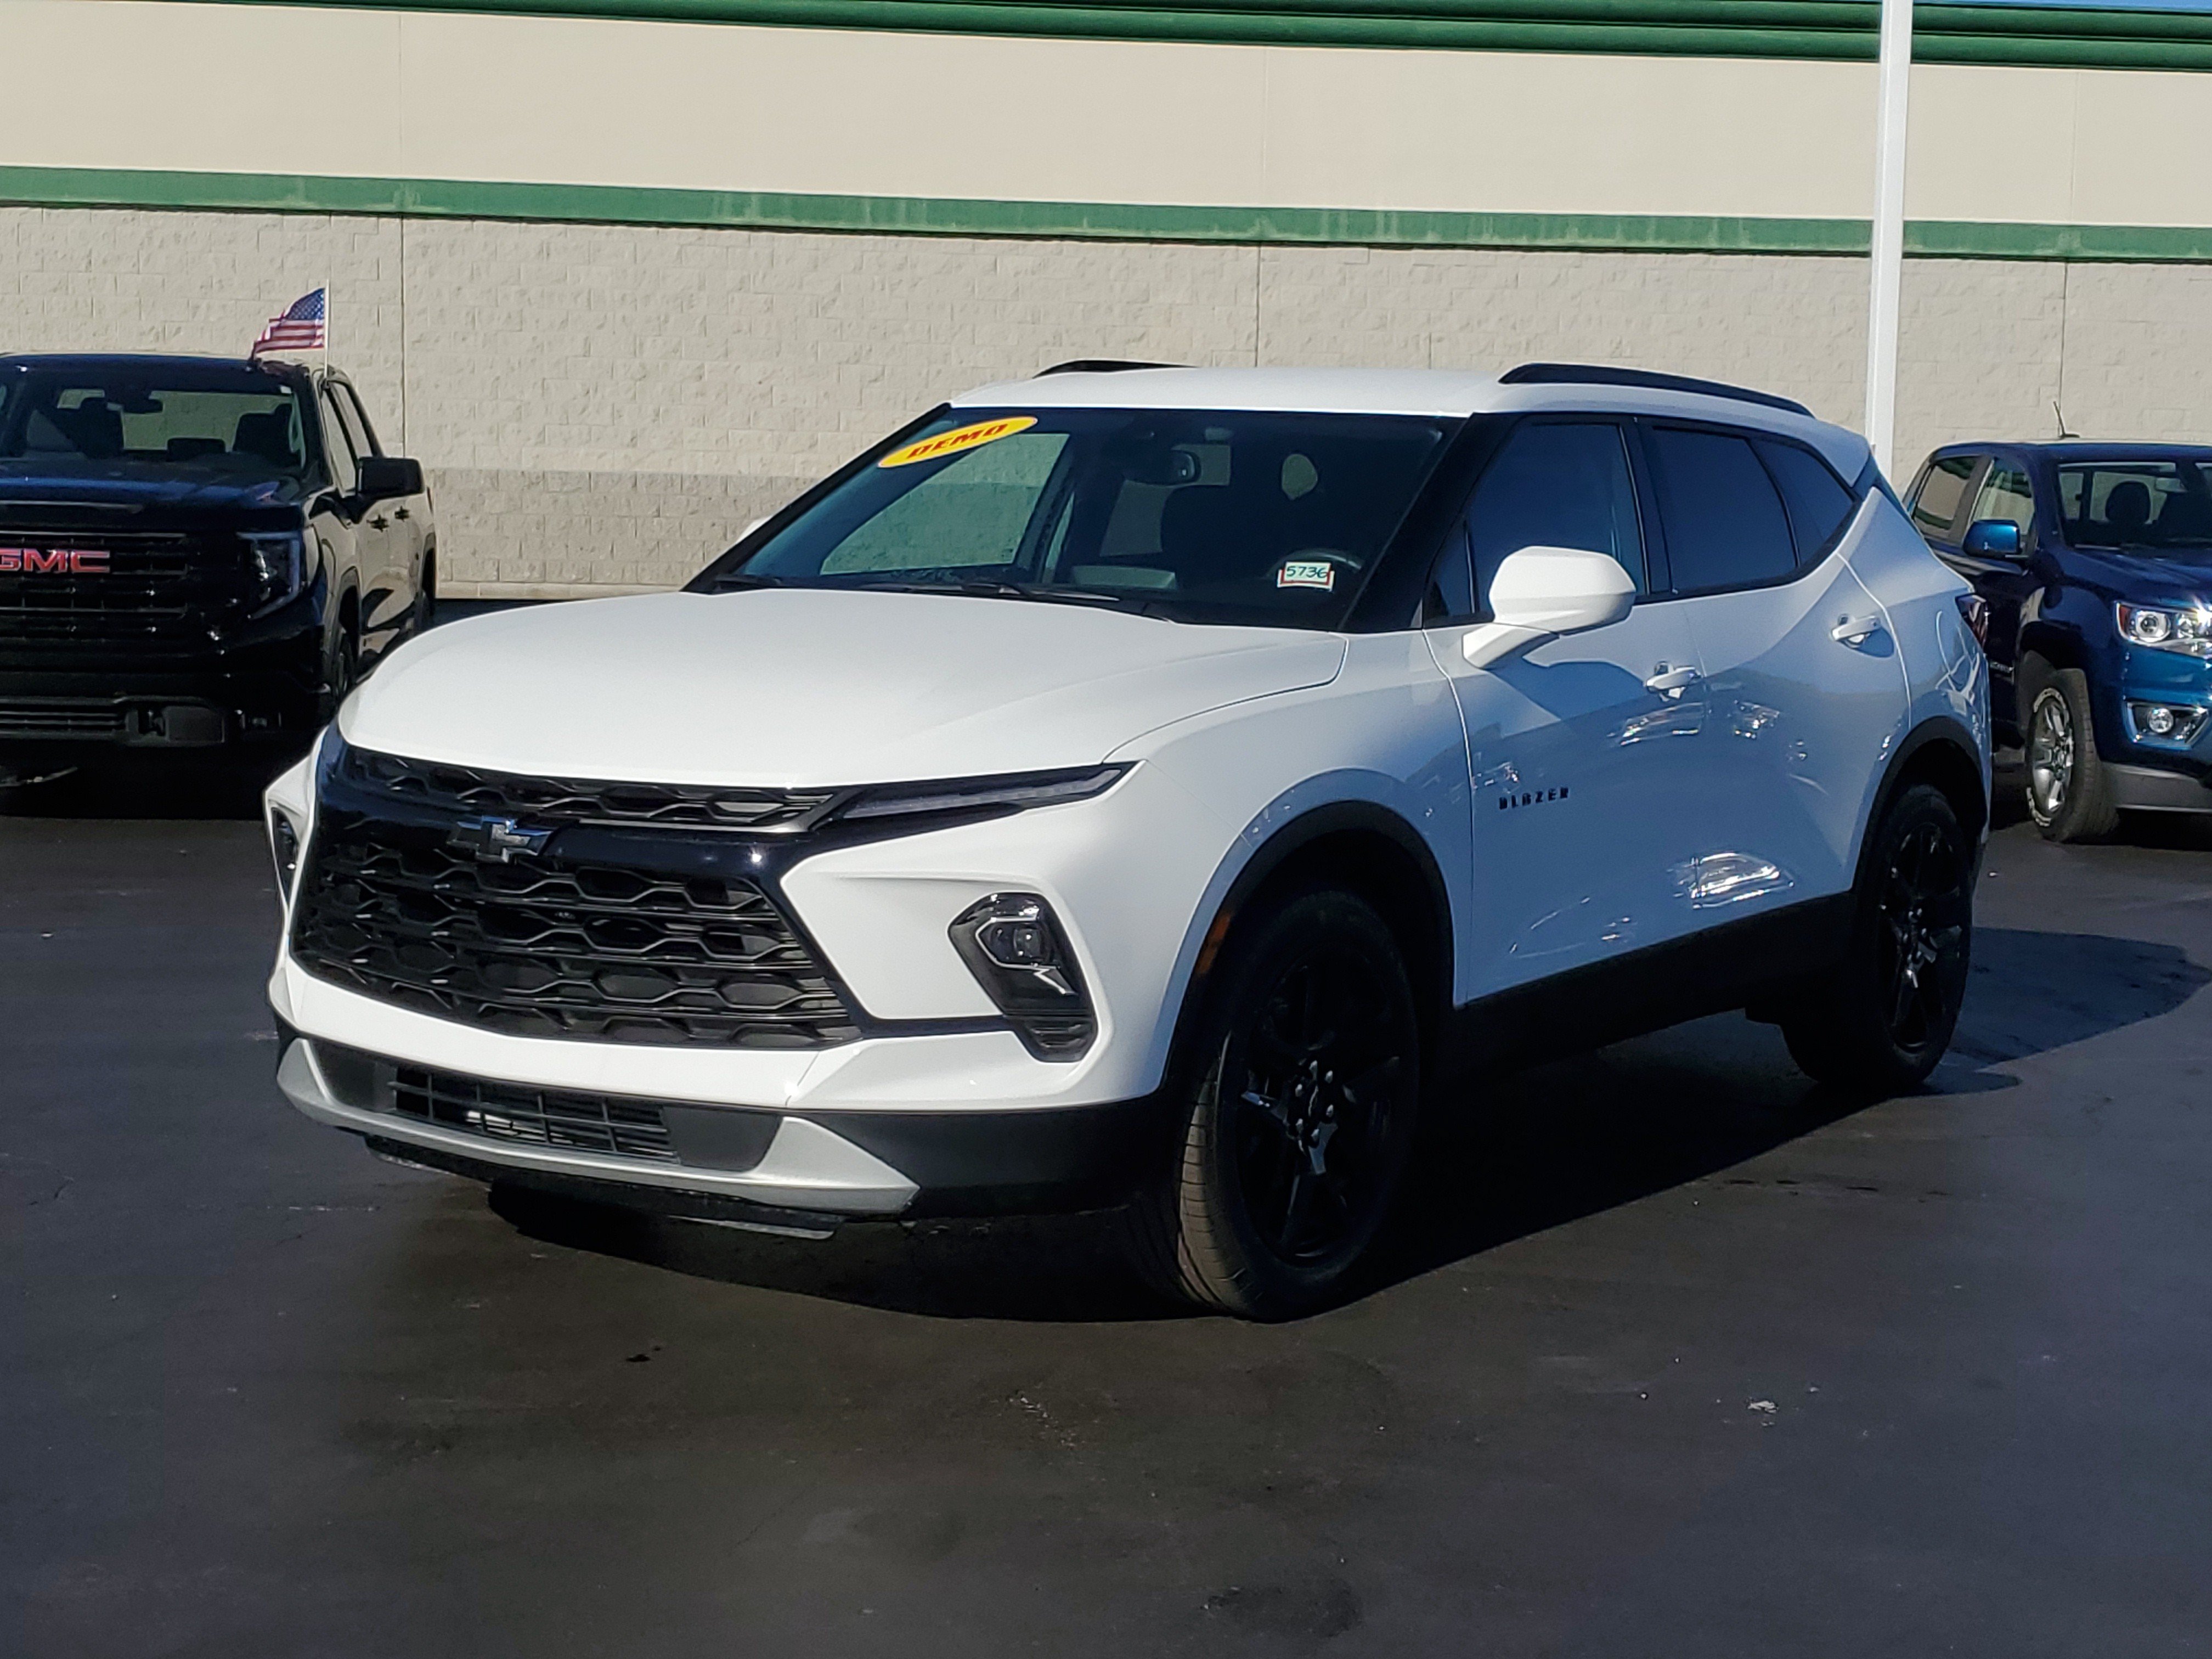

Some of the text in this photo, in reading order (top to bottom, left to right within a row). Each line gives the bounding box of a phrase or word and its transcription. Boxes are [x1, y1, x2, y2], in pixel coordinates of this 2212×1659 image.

[906, 424, 1008, 459] DEMO
[1286, 566, 1328, 578] 5736
[1499, 787, 1569, 810] BLAZER
